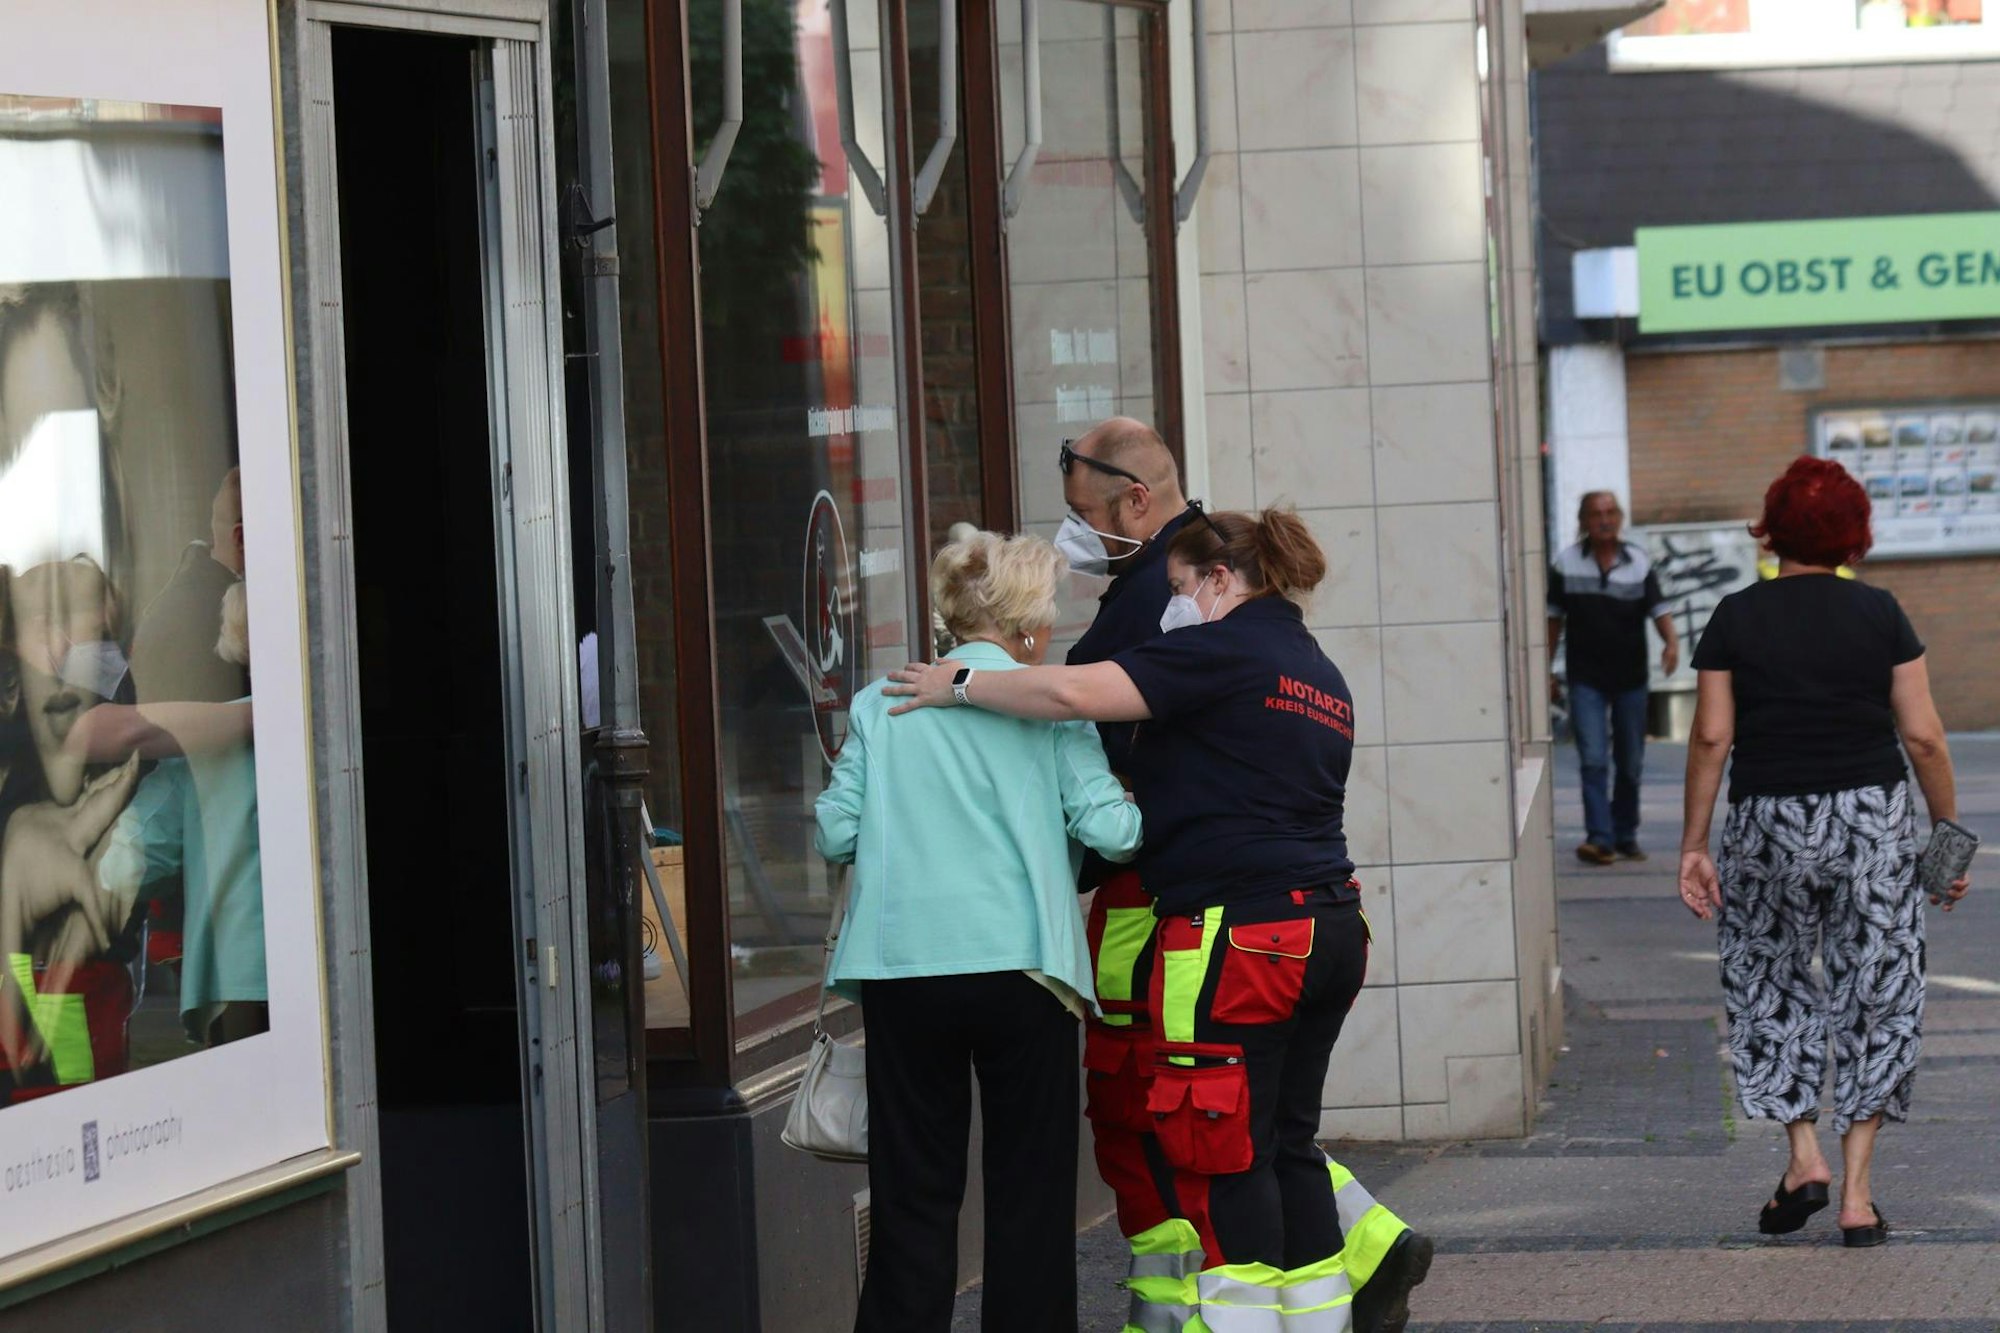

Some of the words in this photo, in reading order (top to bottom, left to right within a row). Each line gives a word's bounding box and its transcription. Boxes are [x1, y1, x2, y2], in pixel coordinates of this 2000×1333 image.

[1672, 263, 1725, 298] EU
[1739, 258, 1853, 296] OBST
[1870, 256, 1901, 291] &
[1265, 696, 1305, 715] KREIS
[1278, 675, 1351, 721] NOTARZT
